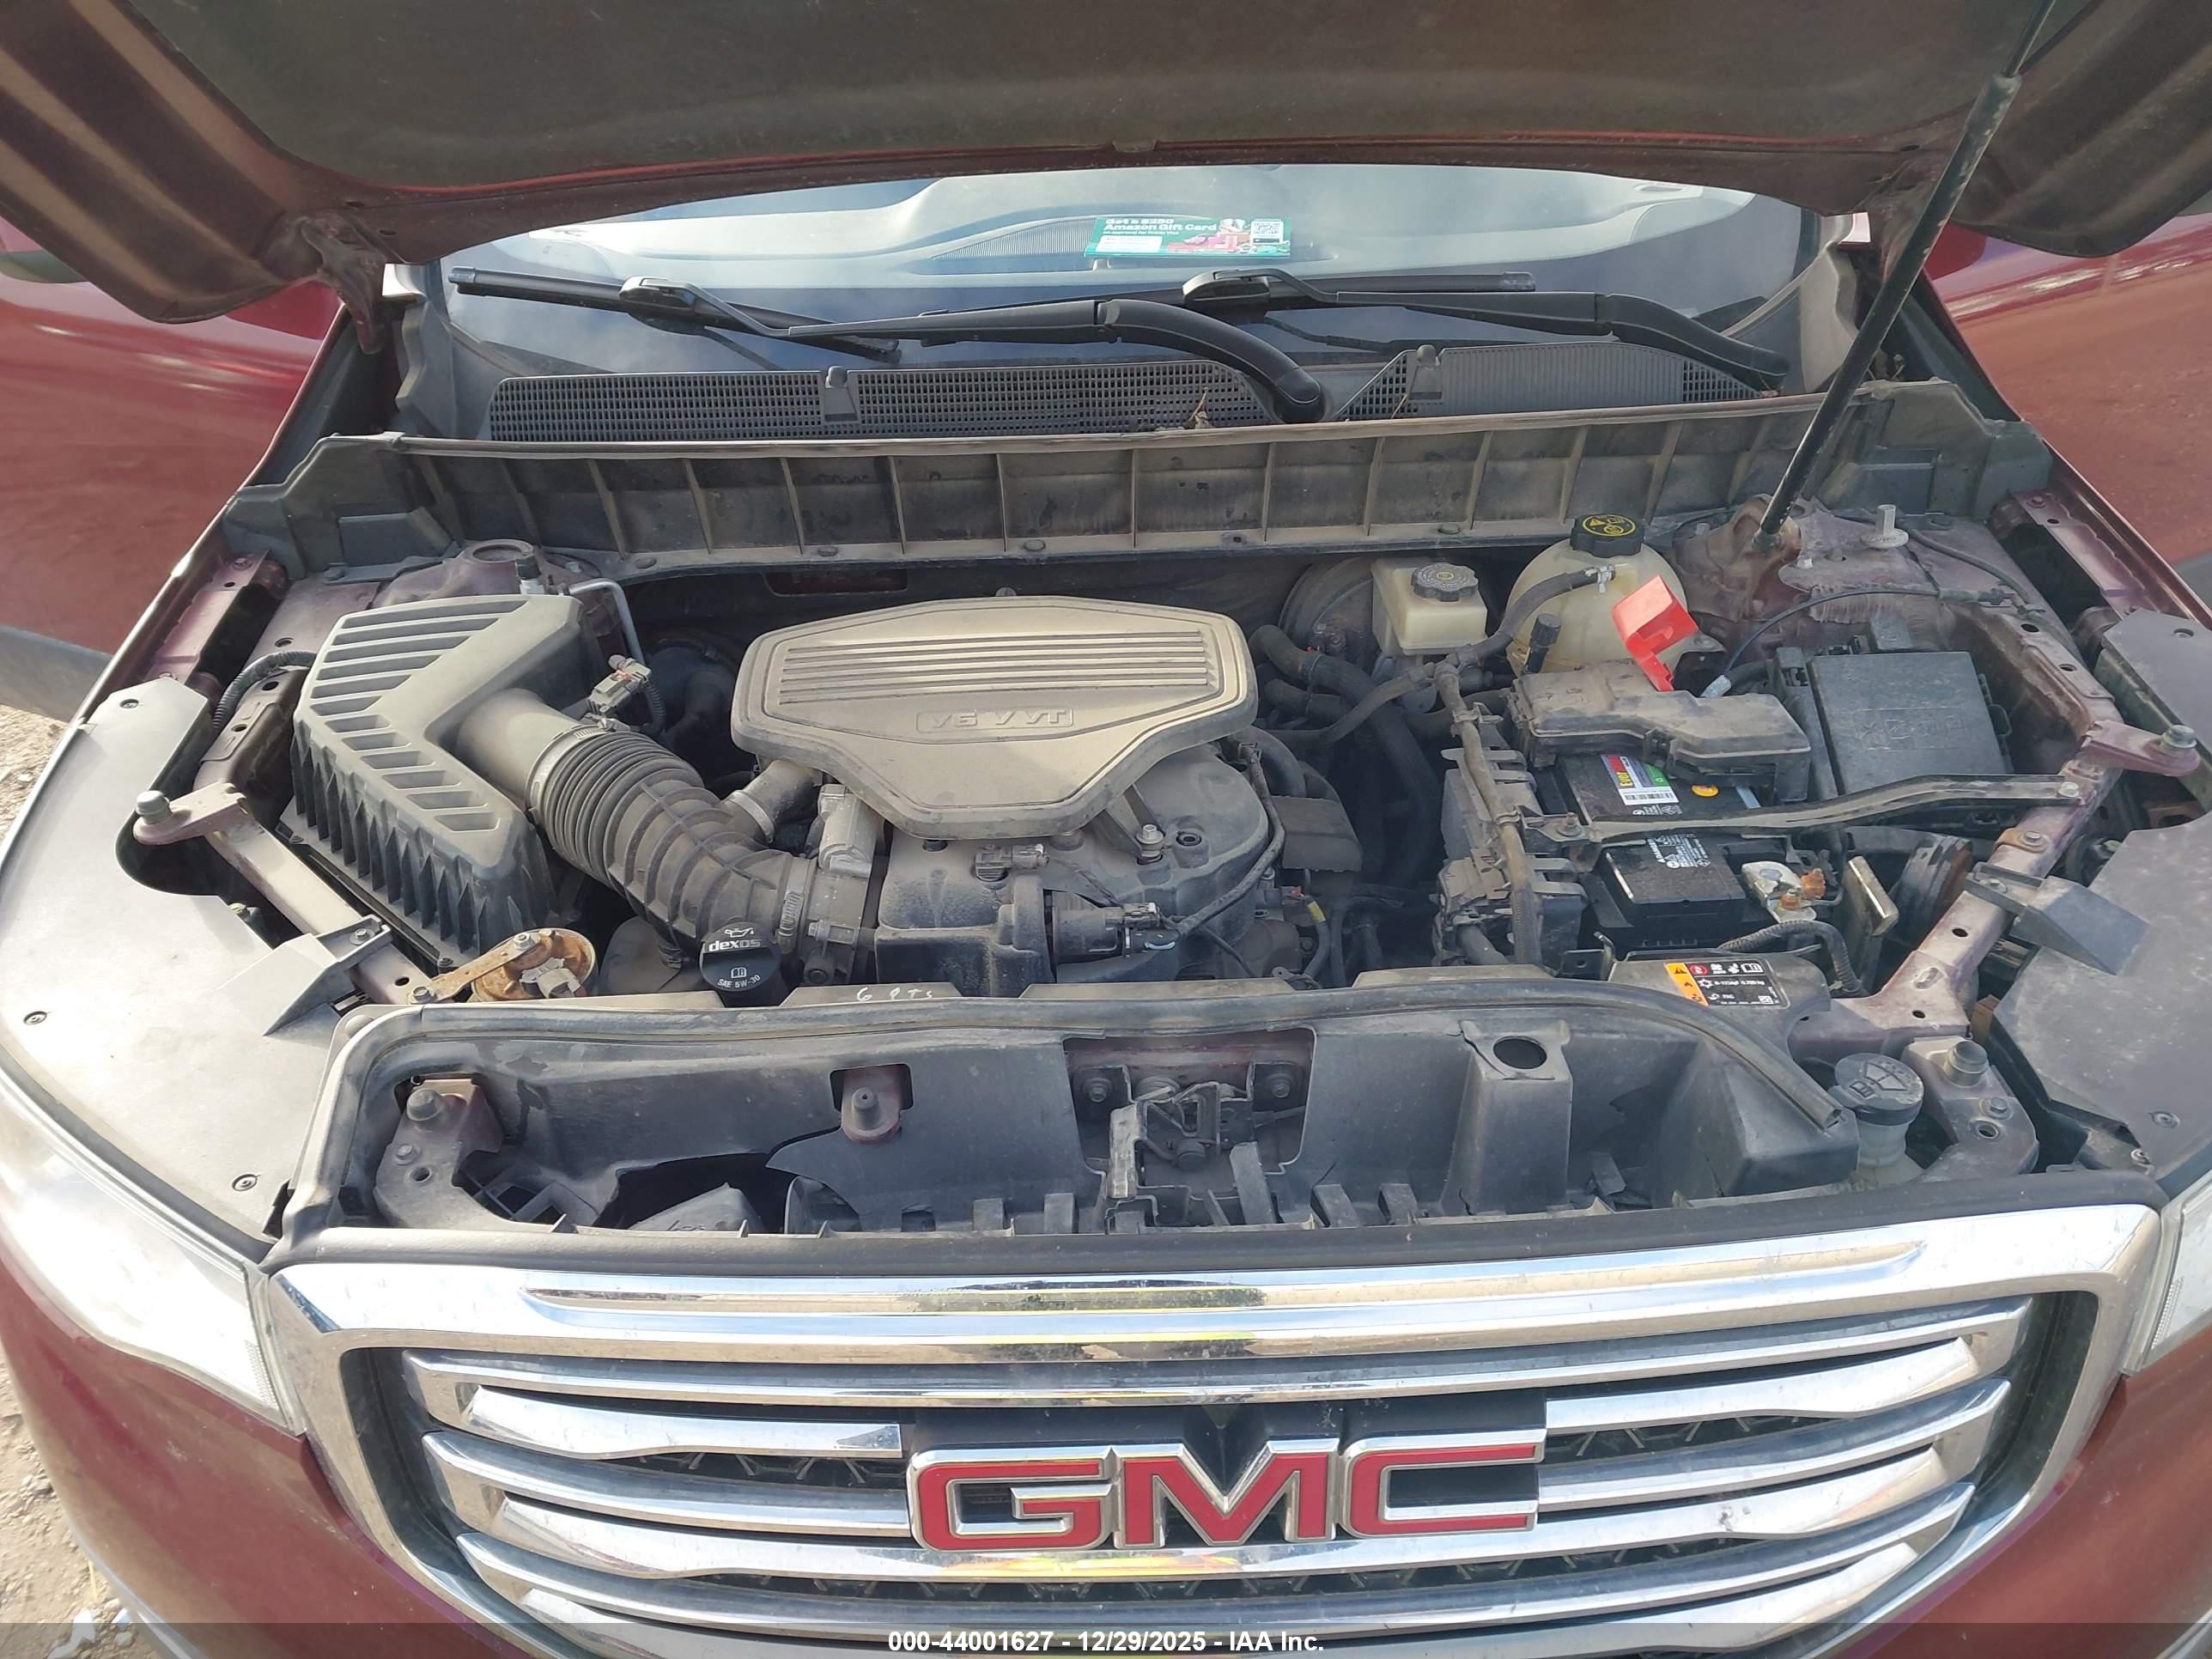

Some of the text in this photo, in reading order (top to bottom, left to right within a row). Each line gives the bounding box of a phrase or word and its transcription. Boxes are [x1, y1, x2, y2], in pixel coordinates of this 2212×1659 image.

[933, 708, 1066, 729] V6 VVT
[708, 939, 763, 952] dexos
[717, 974, 761, 988] SAE 5W-30
[907, 1429, 1546, 1552] GMC
